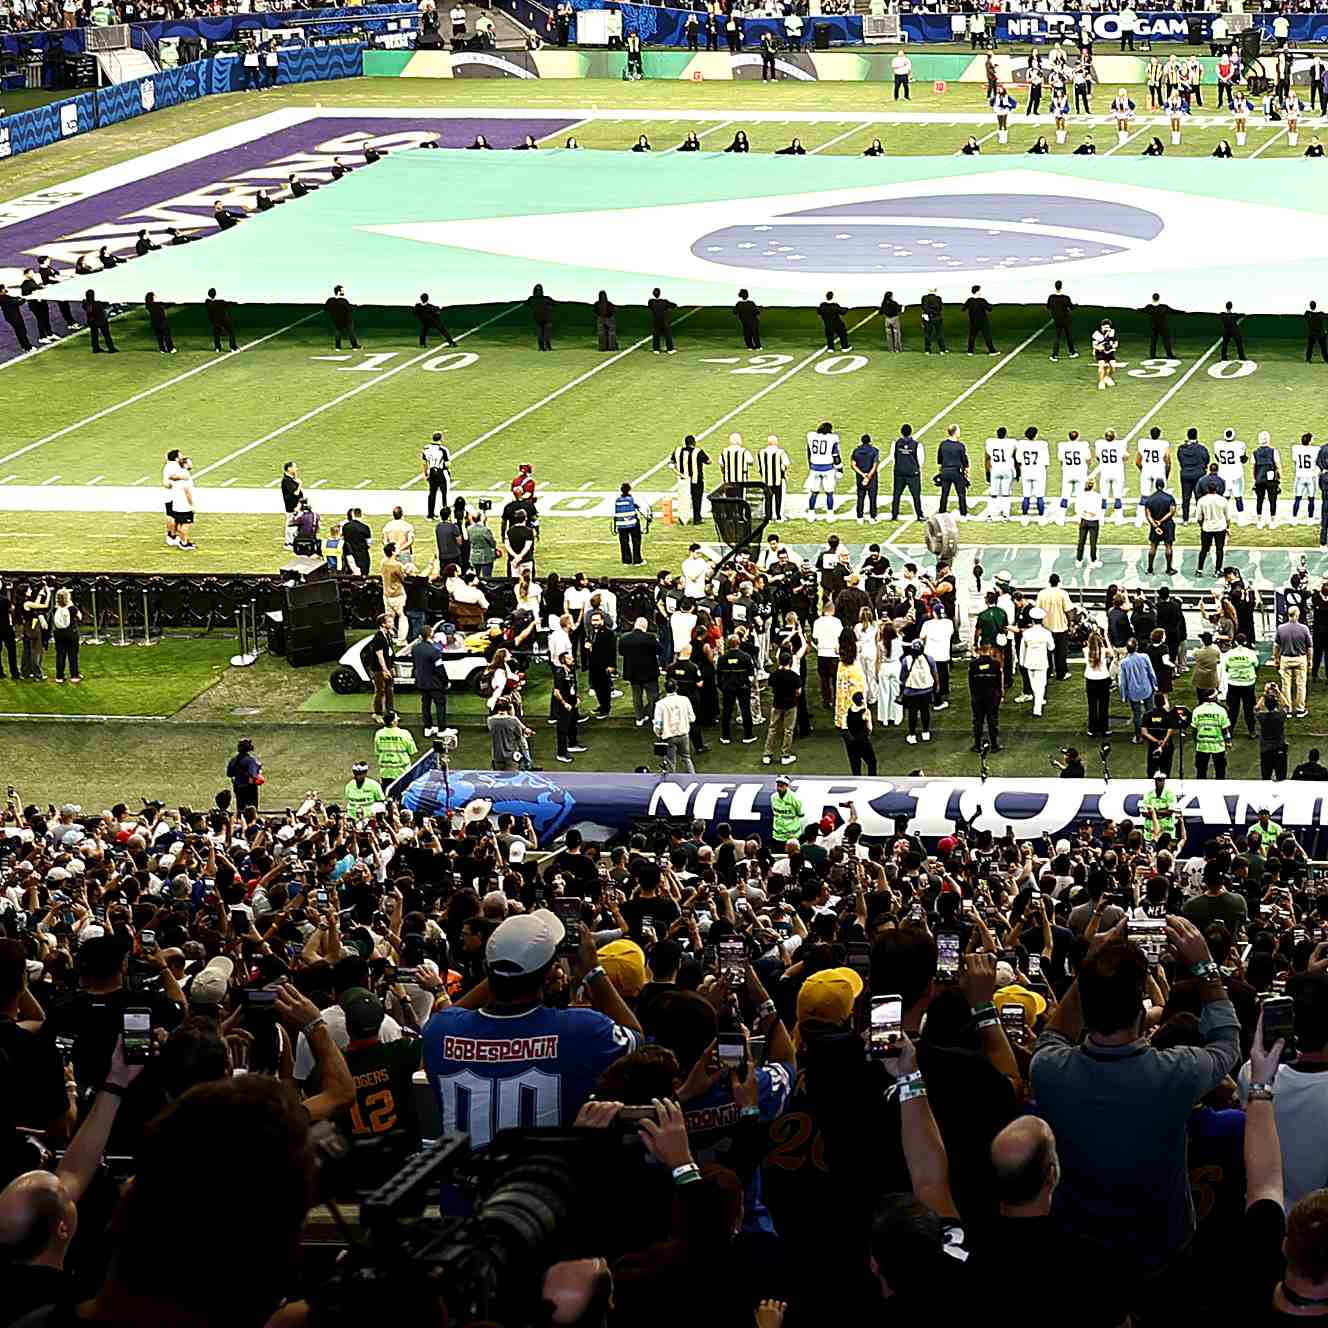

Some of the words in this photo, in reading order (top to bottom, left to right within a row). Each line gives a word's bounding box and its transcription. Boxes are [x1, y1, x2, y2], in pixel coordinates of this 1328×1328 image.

[1008, 19, 1039, 35] NFL
[337, 351, 480, 373] 10
[728, 354, 870, 376] 20
[1127, 358, 1258, 380] 30
[812, 439, 828, 455] 60
[992, 448, 1007, 463] 51
[1023, 450, 1038, 466] 67
[1064, 451, 1081, 466] 56
[1101, 449, 1117, 464] 66
[1143, 449, 1159, 463] 78
[1219, 449, 1235, 465] 52
[1298, 453, 1312, 469] 16
[648, 781, 764, 821] NFL
[780, 778, 1090, 838] RIO
[443, 1034, 560, 1063] BOBESPONJA
[350, 1088, 398, 1134] 12
